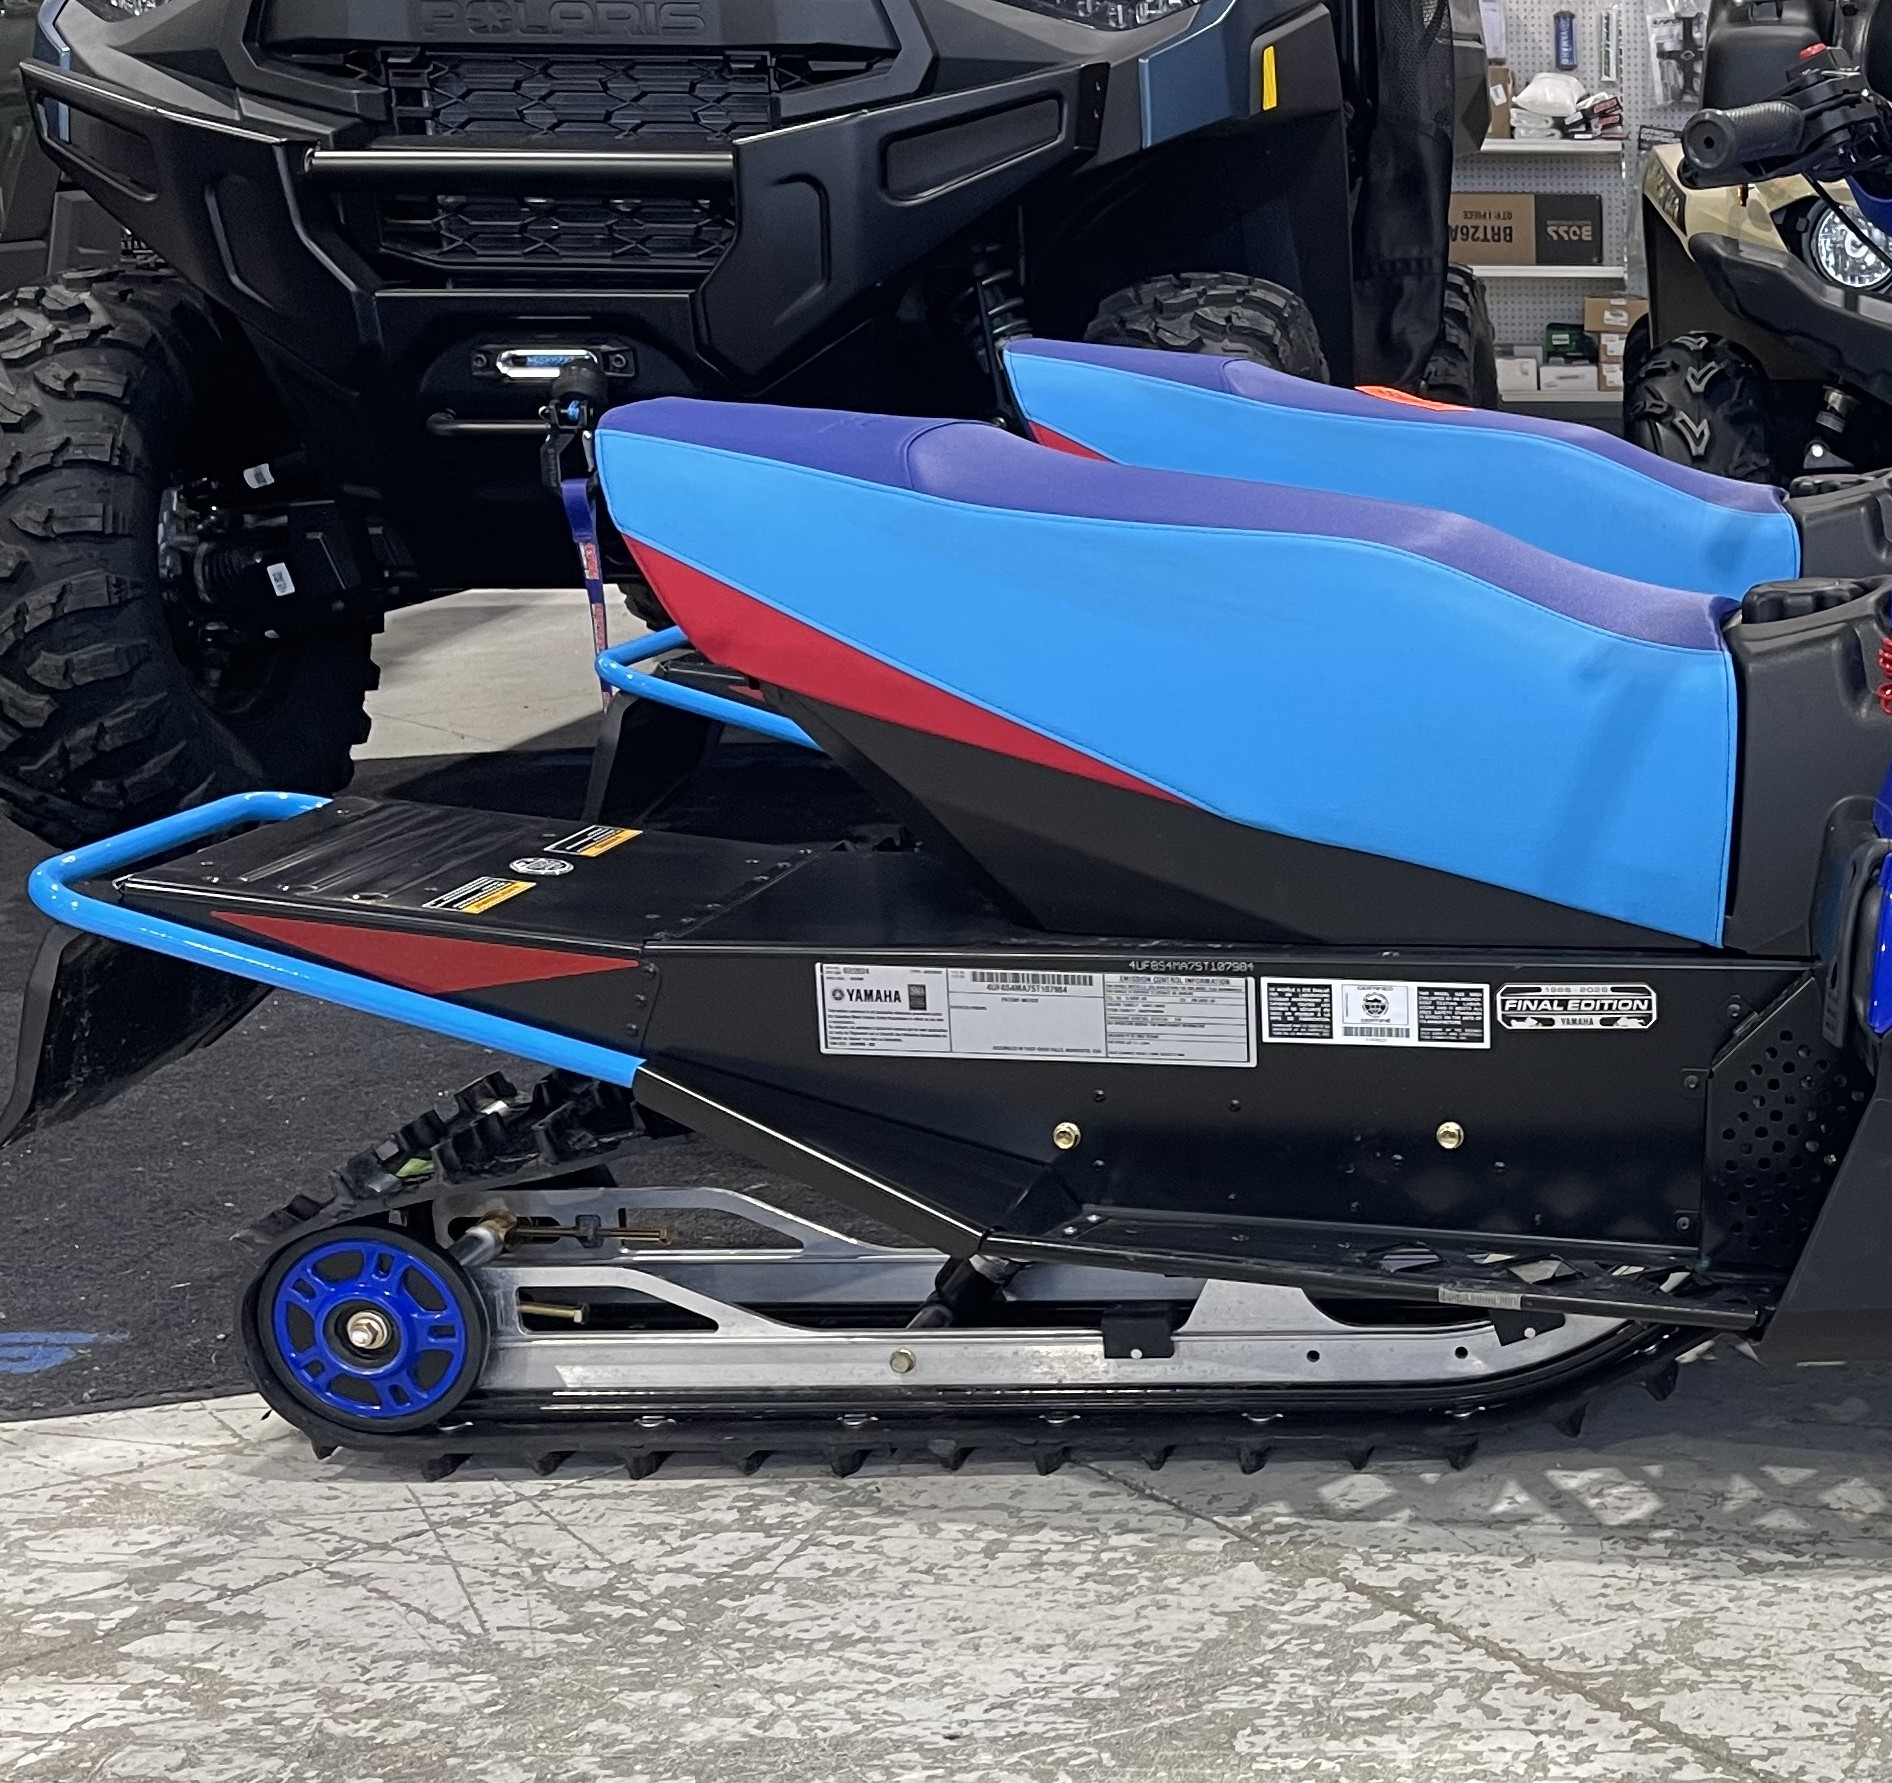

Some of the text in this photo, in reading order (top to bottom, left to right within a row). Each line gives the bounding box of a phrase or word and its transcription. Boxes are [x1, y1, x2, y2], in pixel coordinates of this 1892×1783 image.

[422, 0, 706, 36] POLARIS
[1546, 225, 1593, 241] BOSS
[846, 988, 902, 1003] YAMAHA
[1504, 999, 1649, 1011] FINAL EDITION
[1560, 1017, 1595, 1026] YAMAHA
